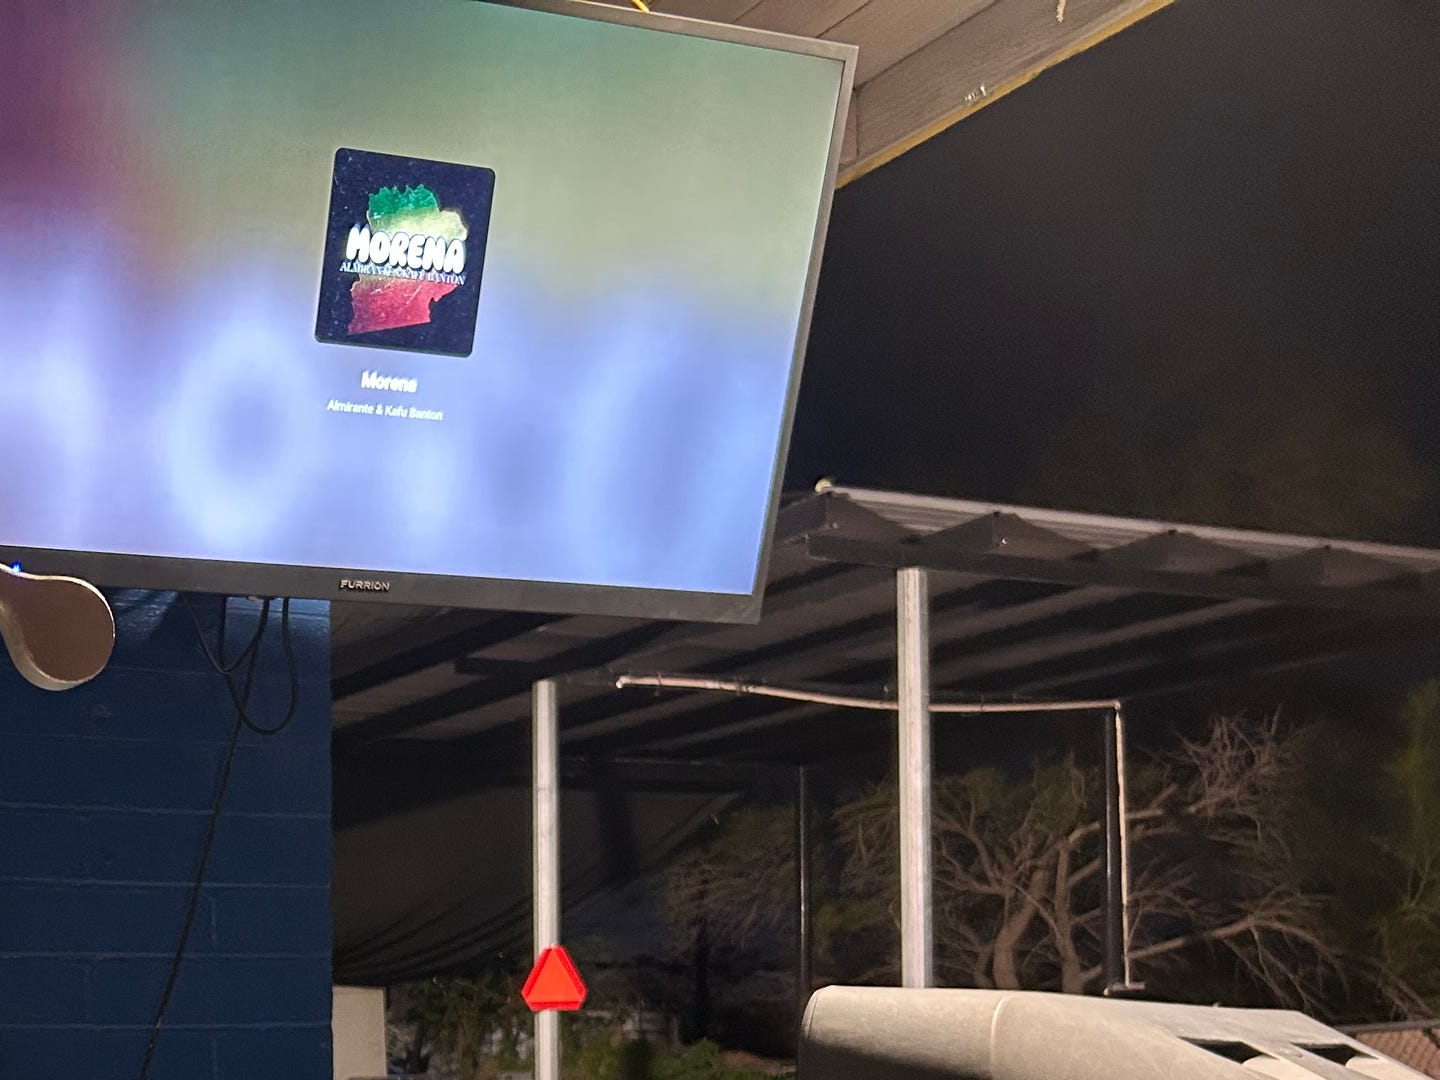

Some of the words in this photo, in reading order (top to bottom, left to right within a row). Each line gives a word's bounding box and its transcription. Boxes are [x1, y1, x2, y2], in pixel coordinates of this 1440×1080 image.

[346, 223, 466, 273] MORENA
[361, 371, 418, 393] Morena
[326, 399, 374, 415] Almirante
[375, 404, 384, 416] &
[385, 405, 408, 418] Kafu
[409, 407, 444, 421] Banton
[340, 579, 390, 591] FURRION
